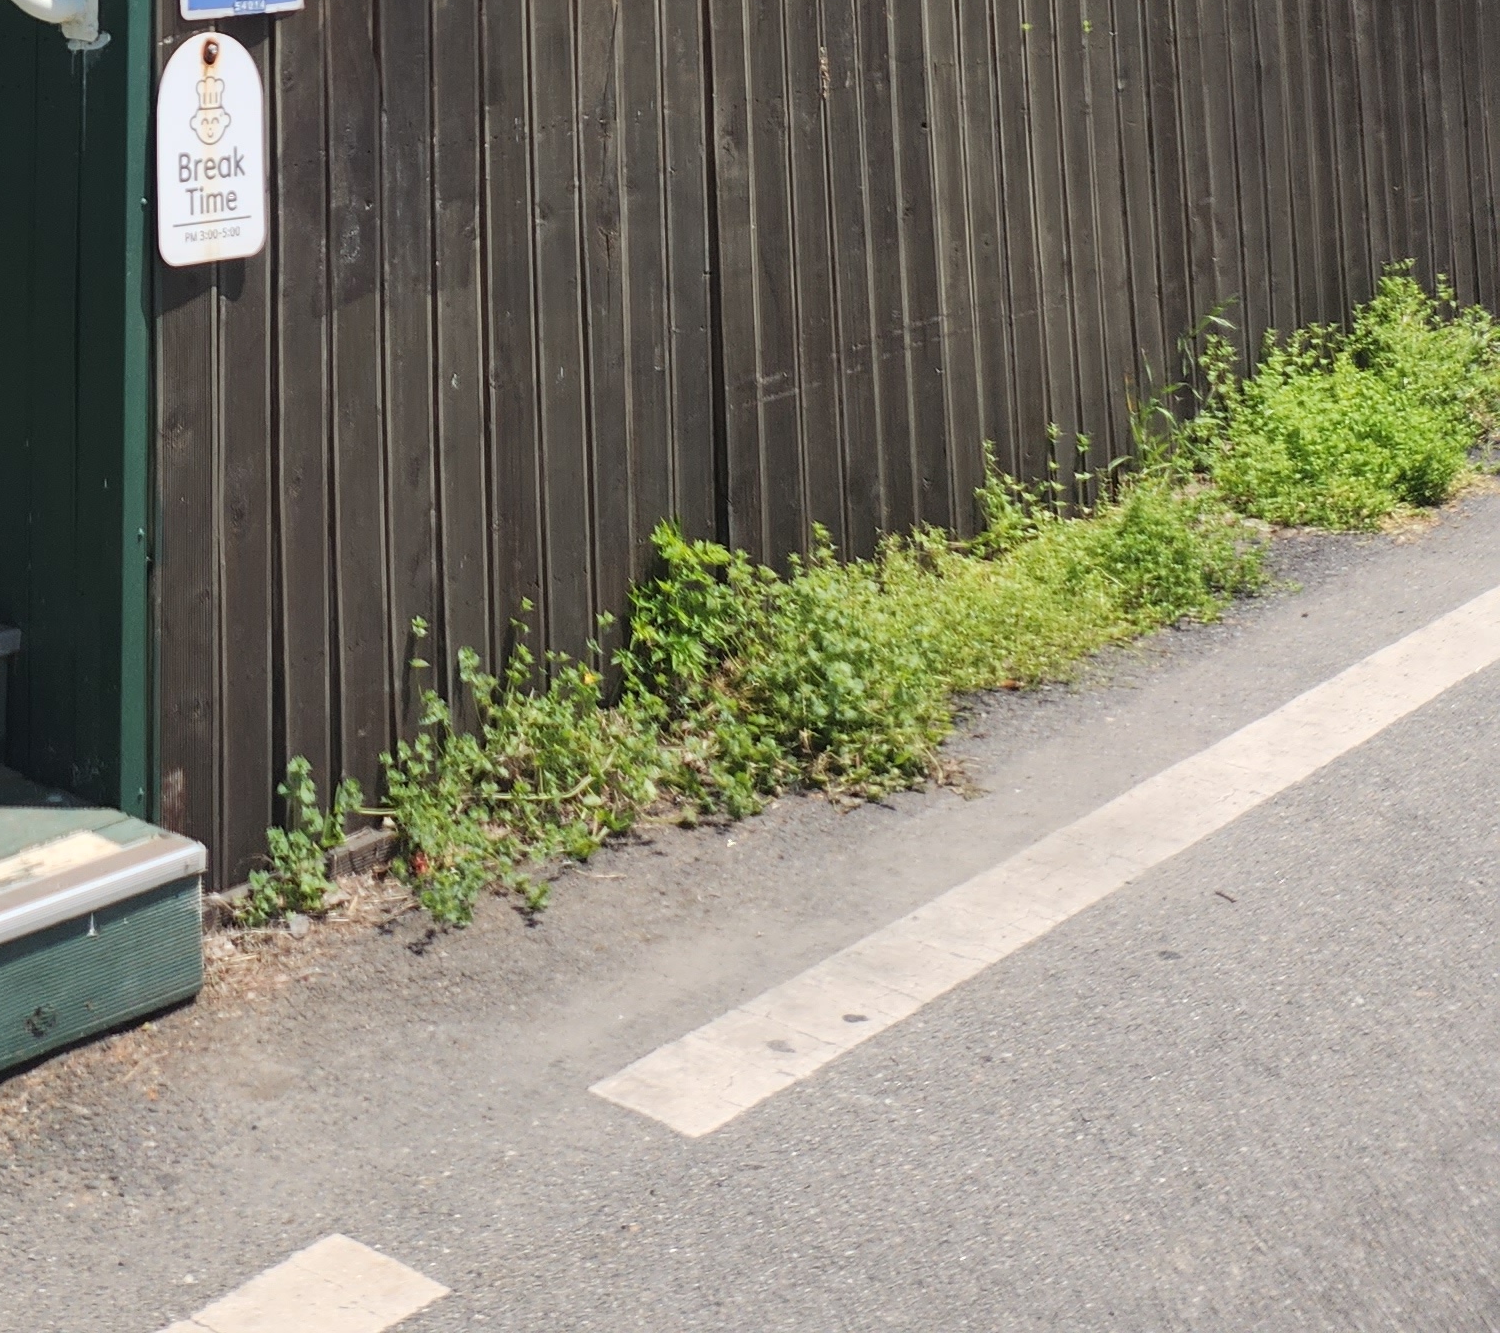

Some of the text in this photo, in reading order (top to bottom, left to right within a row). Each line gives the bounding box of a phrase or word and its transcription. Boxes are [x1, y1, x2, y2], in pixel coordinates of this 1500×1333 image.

[178, 145, 246, 183] Break
[185, 186, 238, 215] Time
[185, 232, 197, 242] PM
